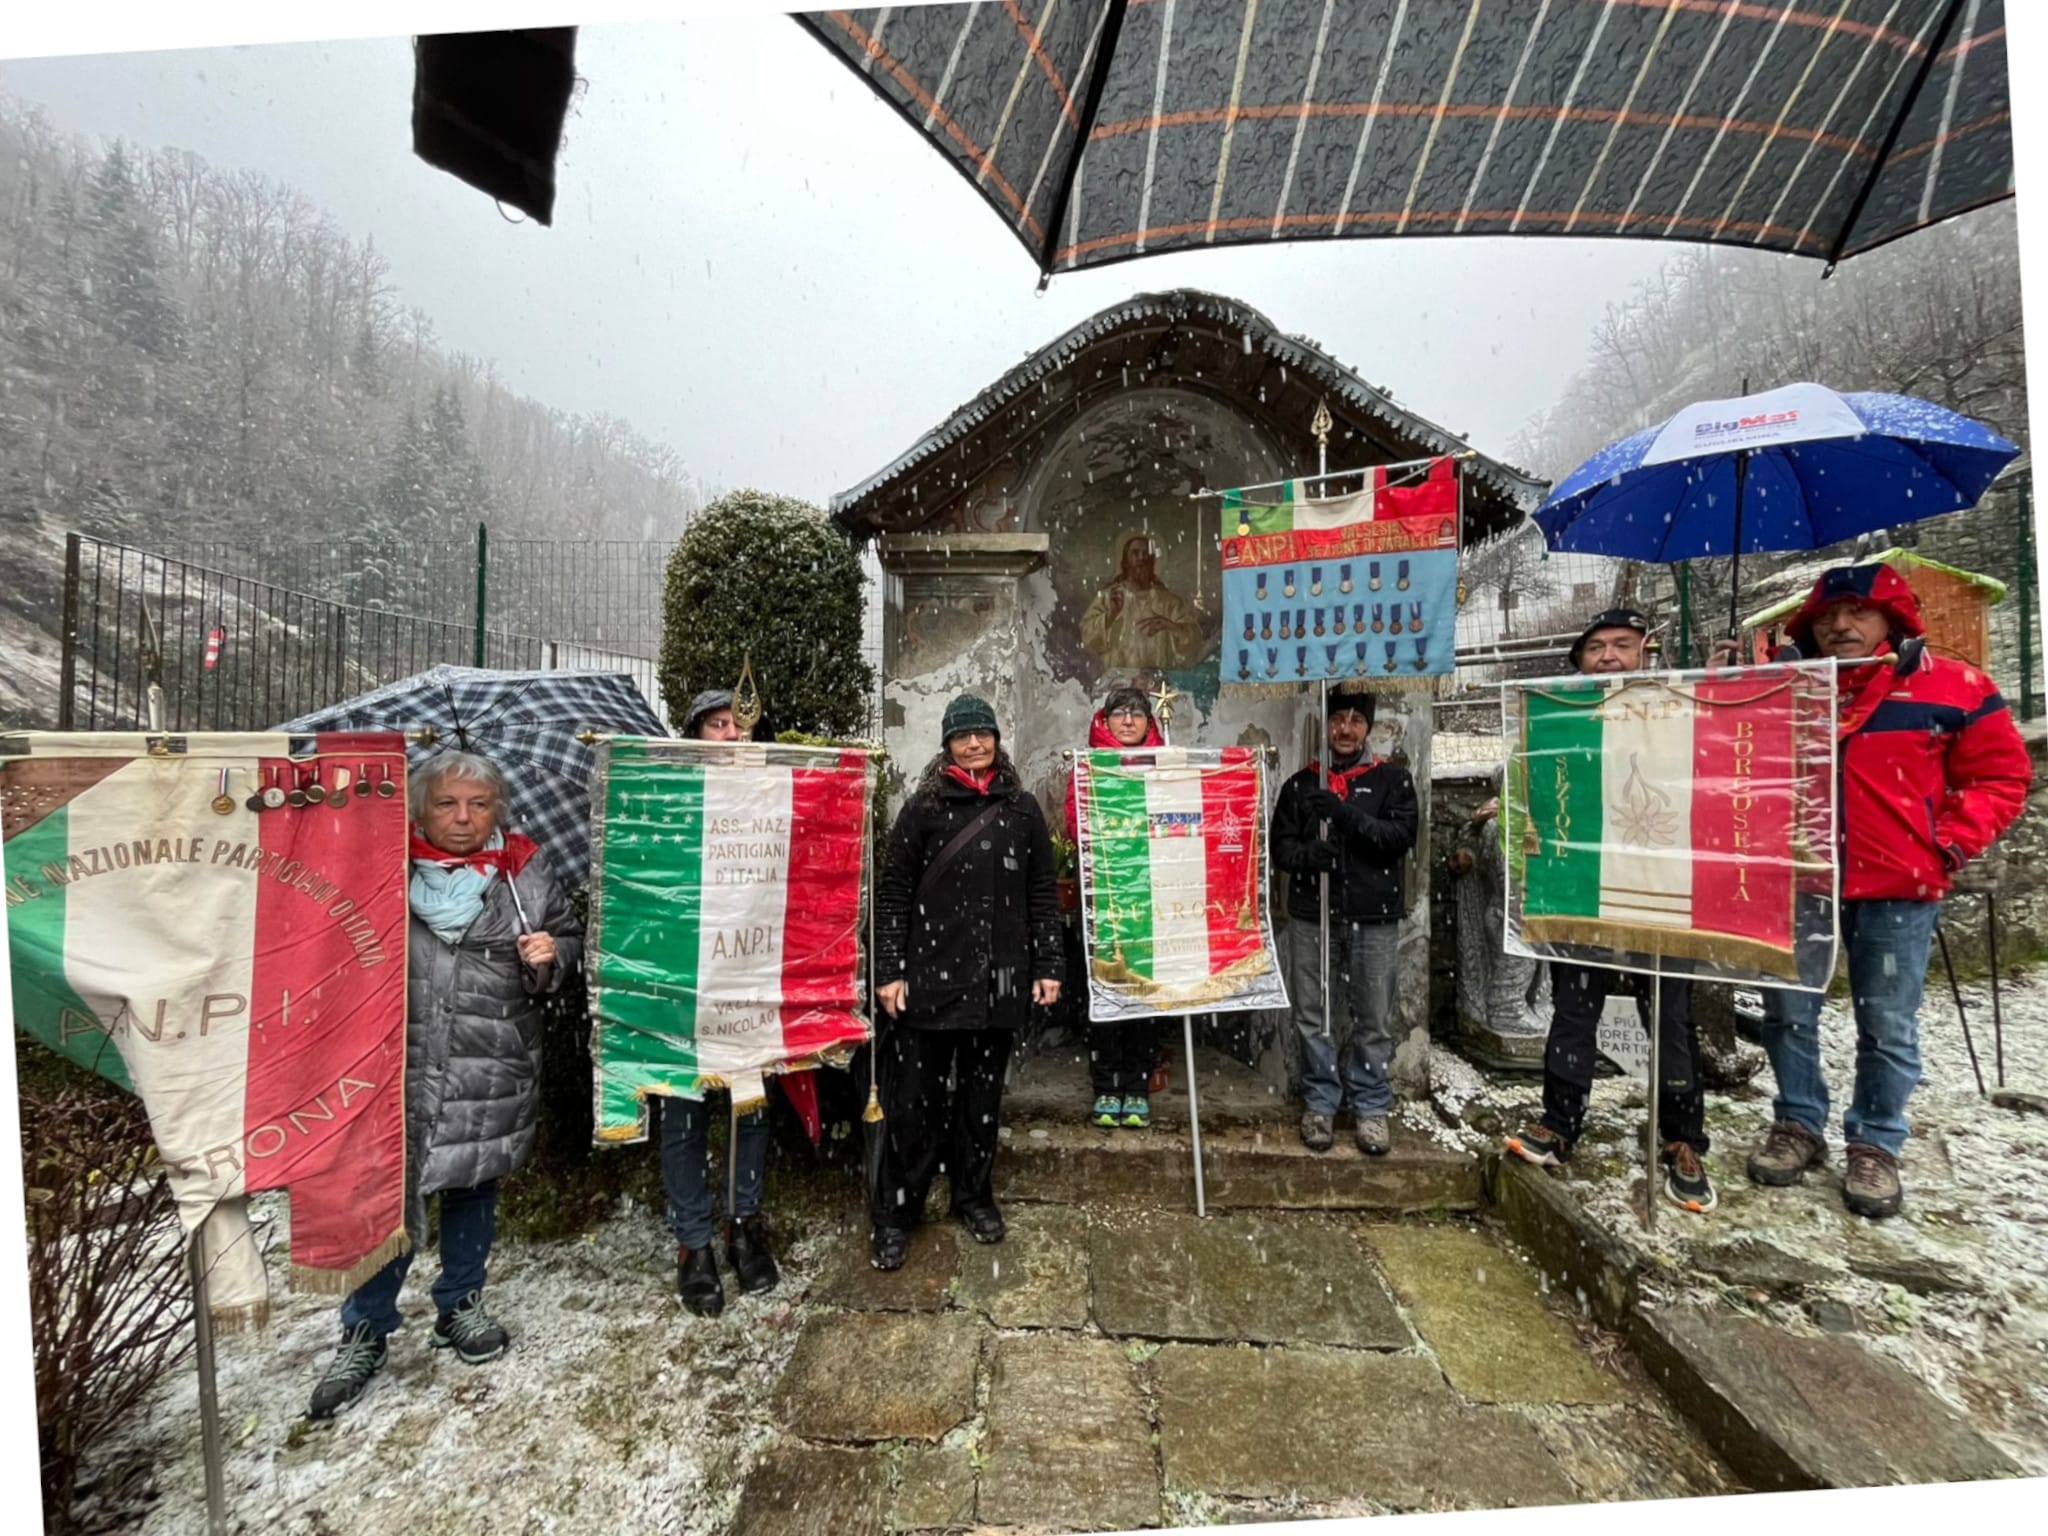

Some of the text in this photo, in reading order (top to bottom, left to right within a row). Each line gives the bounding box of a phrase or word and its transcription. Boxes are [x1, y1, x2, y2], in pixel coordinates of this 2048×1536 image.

[1241, 535, 1296, 566] ANPI
[1555, 756, 1571, 858] SEZIONE
[710, 819, 743, 834] ASS.
[708, 843, 785, 860] PARTIGIANI
[40, 838, 205, 887] NAZIONALE
[210, 840, 341, 905] PARTIGIANI
[716, 867, 777, 885] D'ITALIA
[712, 926, 774, 960] A.N.P.I.
